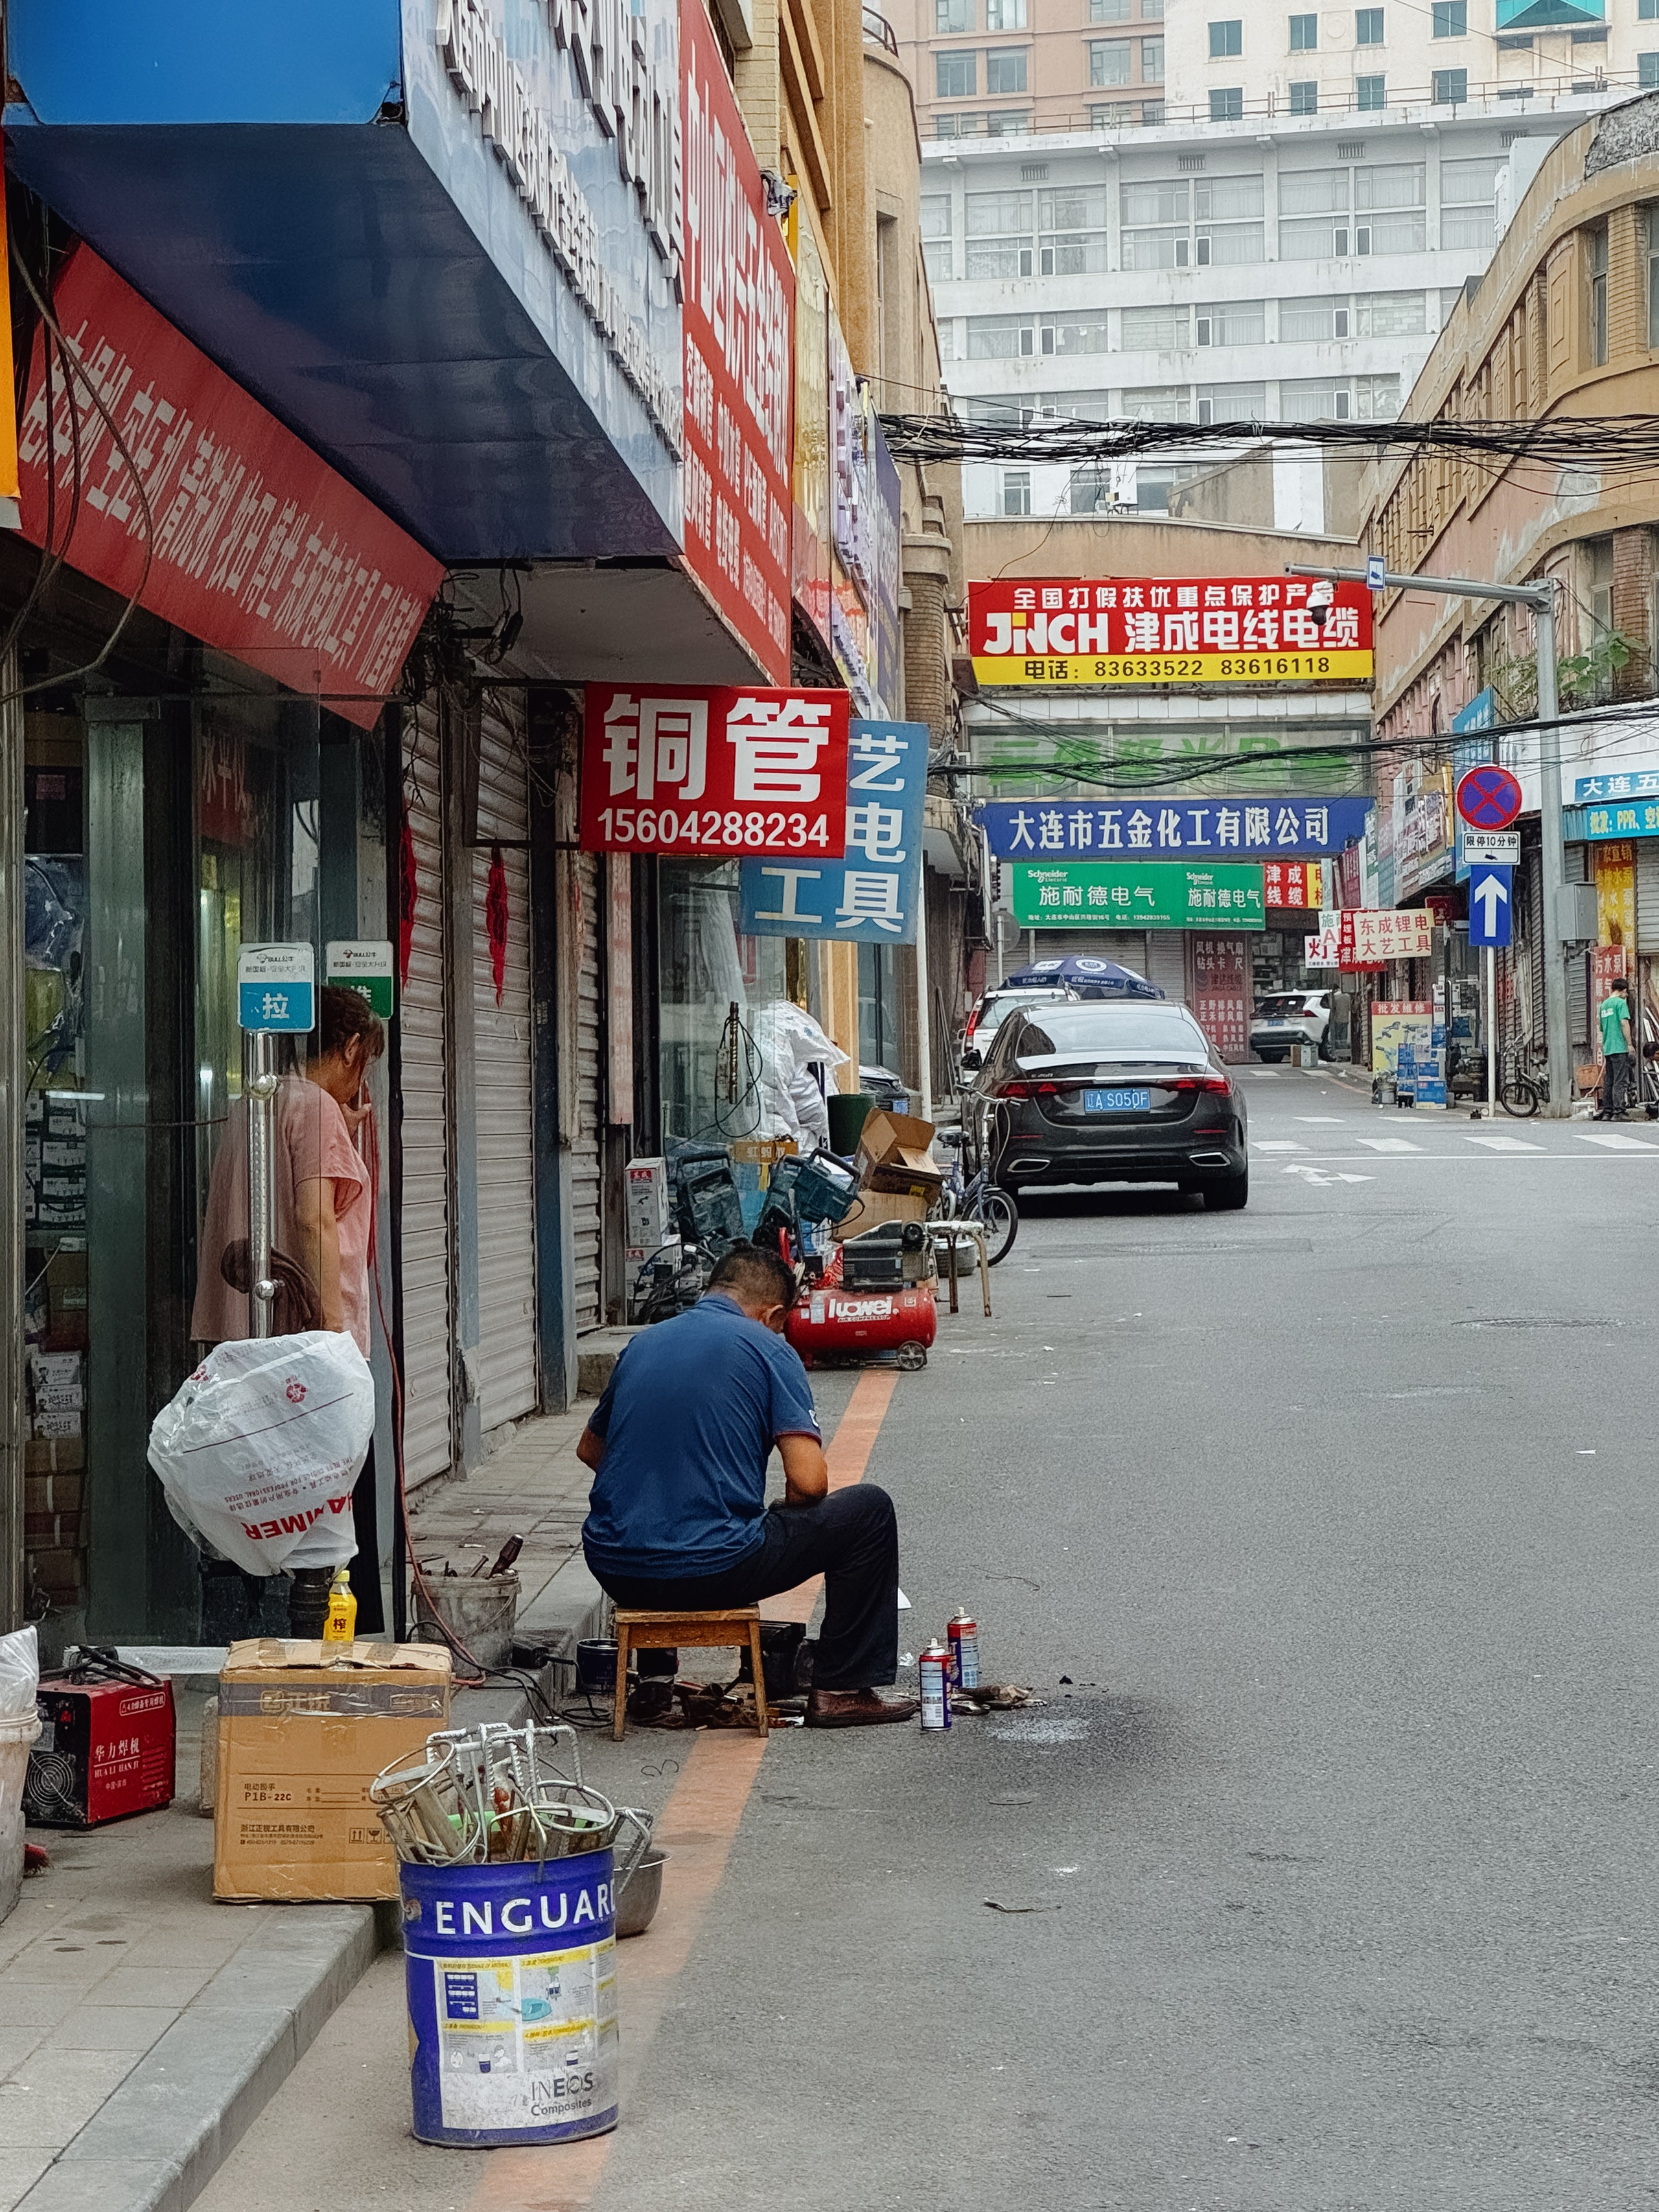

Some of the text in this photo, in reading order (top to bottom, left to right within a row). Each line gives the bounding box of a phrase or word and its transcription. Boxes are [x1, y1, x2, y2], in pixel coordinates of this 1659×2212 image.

[86, 380, 192, 541] 空压机
[152, 428, 245, 579] 清洗机
[207, 471, 277, 598] 牧田
[240, 496, 308, 618] 博世
[1125, 607, 1360, 652] 津成电线电缆
[1095, 660, 1203, 677] 83633522
[1221, 657, 1330, 674] 83616118
[603, 693, 831, 802] 铜管
[597, 808, 829, 847] 15604288234
[1009, 806, 1328, 850] 大连市五金化工有限公司
[1467, 836, 1516, 847] 限停10分钟
[1027, 870, 1068, 879] Schneider
[1267, 865, 1302, 884] 津成
[754, 867, 904, 933] 工具
[1039, 885, 1155, 907] 施耐德电气
[1188, 889, 1260, 908] 施耐德电气
[1267, 886, 1303, 906] 线缆
[1360, 914, 1429, 935] 东成锂电
[1309, 938, 1339, 959] 灯
[1362, 935, 1432, 956] 大艺工具
[262, 993, 290, 1019] 拉
[1378, 1003, 1425, 1014] 批发维修
[244, 1482, 289, 1496] PROFESSIONAL
[290, 1476, 301, 1485] FOR
[224, 1491, 243, 1503] USERS
[333, 1618, 346, 1630] 榨
[95, 1738, 139, 1762] 华力焊机
[95, 1767, 108, 1778] HUA
[245, 1792, 291, 1802] P1B-22C
[531, 2071, 594, 2101] INEOS
[530, 2097, 592, 2117] Composites
